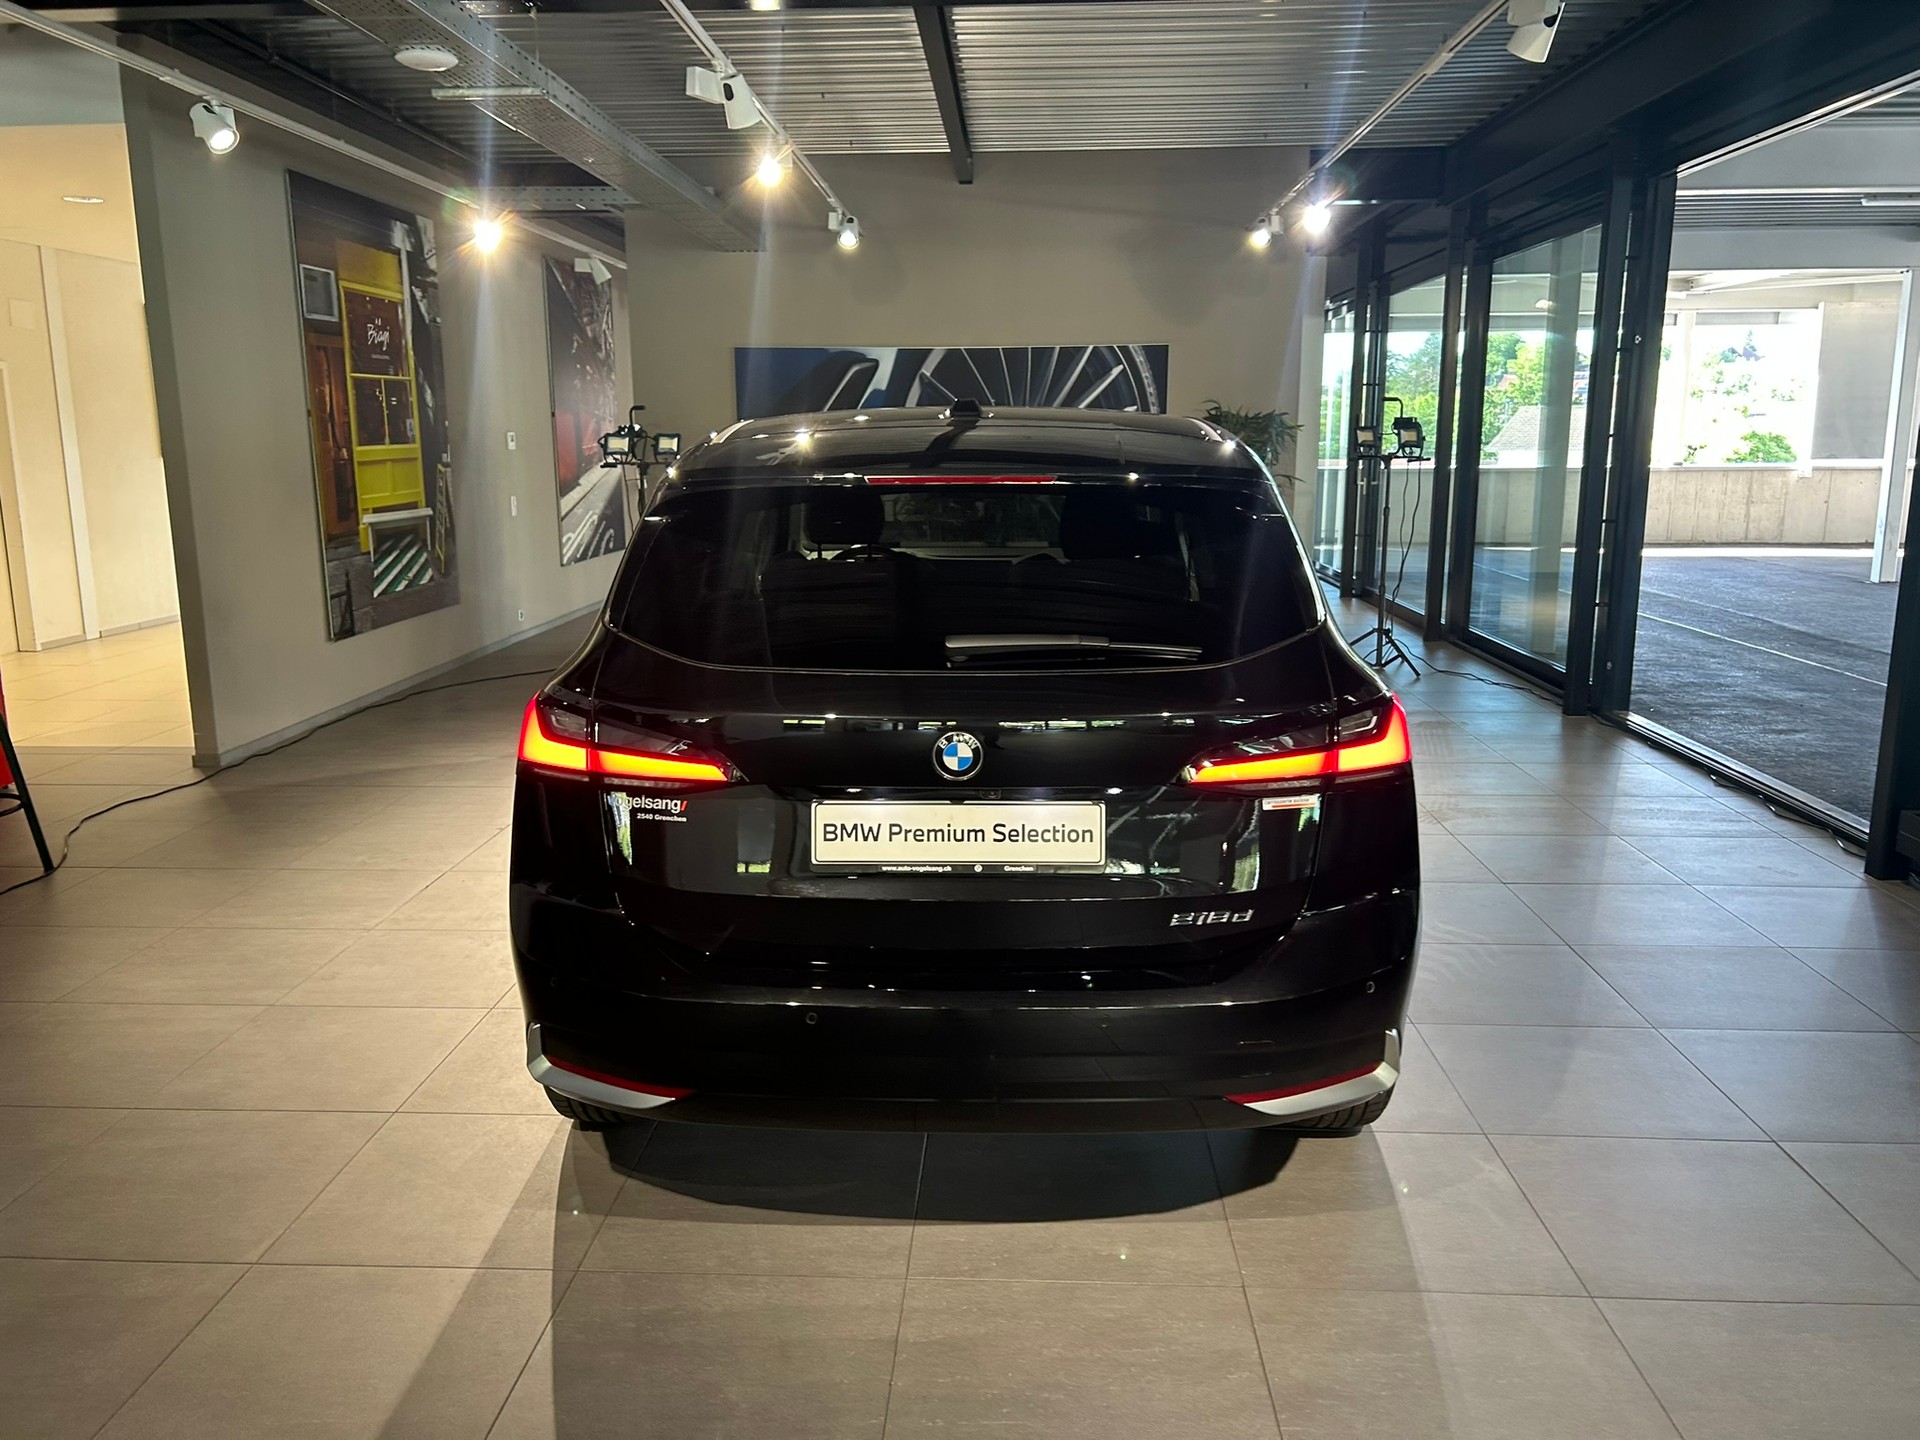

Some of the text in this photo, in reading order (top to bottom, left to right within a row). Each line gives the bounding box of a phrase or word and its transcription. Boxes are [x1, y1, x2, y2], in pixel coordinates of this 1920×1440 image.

[939, 735, 979, 749] BMW
[636, 812, 687, 822] 2540 Grenchen
[823, 822, 1094, 844] BMW Premium Selection
[881, 865, 952, 873] www.auto-vogelsang.ch
[1169, 908, 1255, 926] 218d
